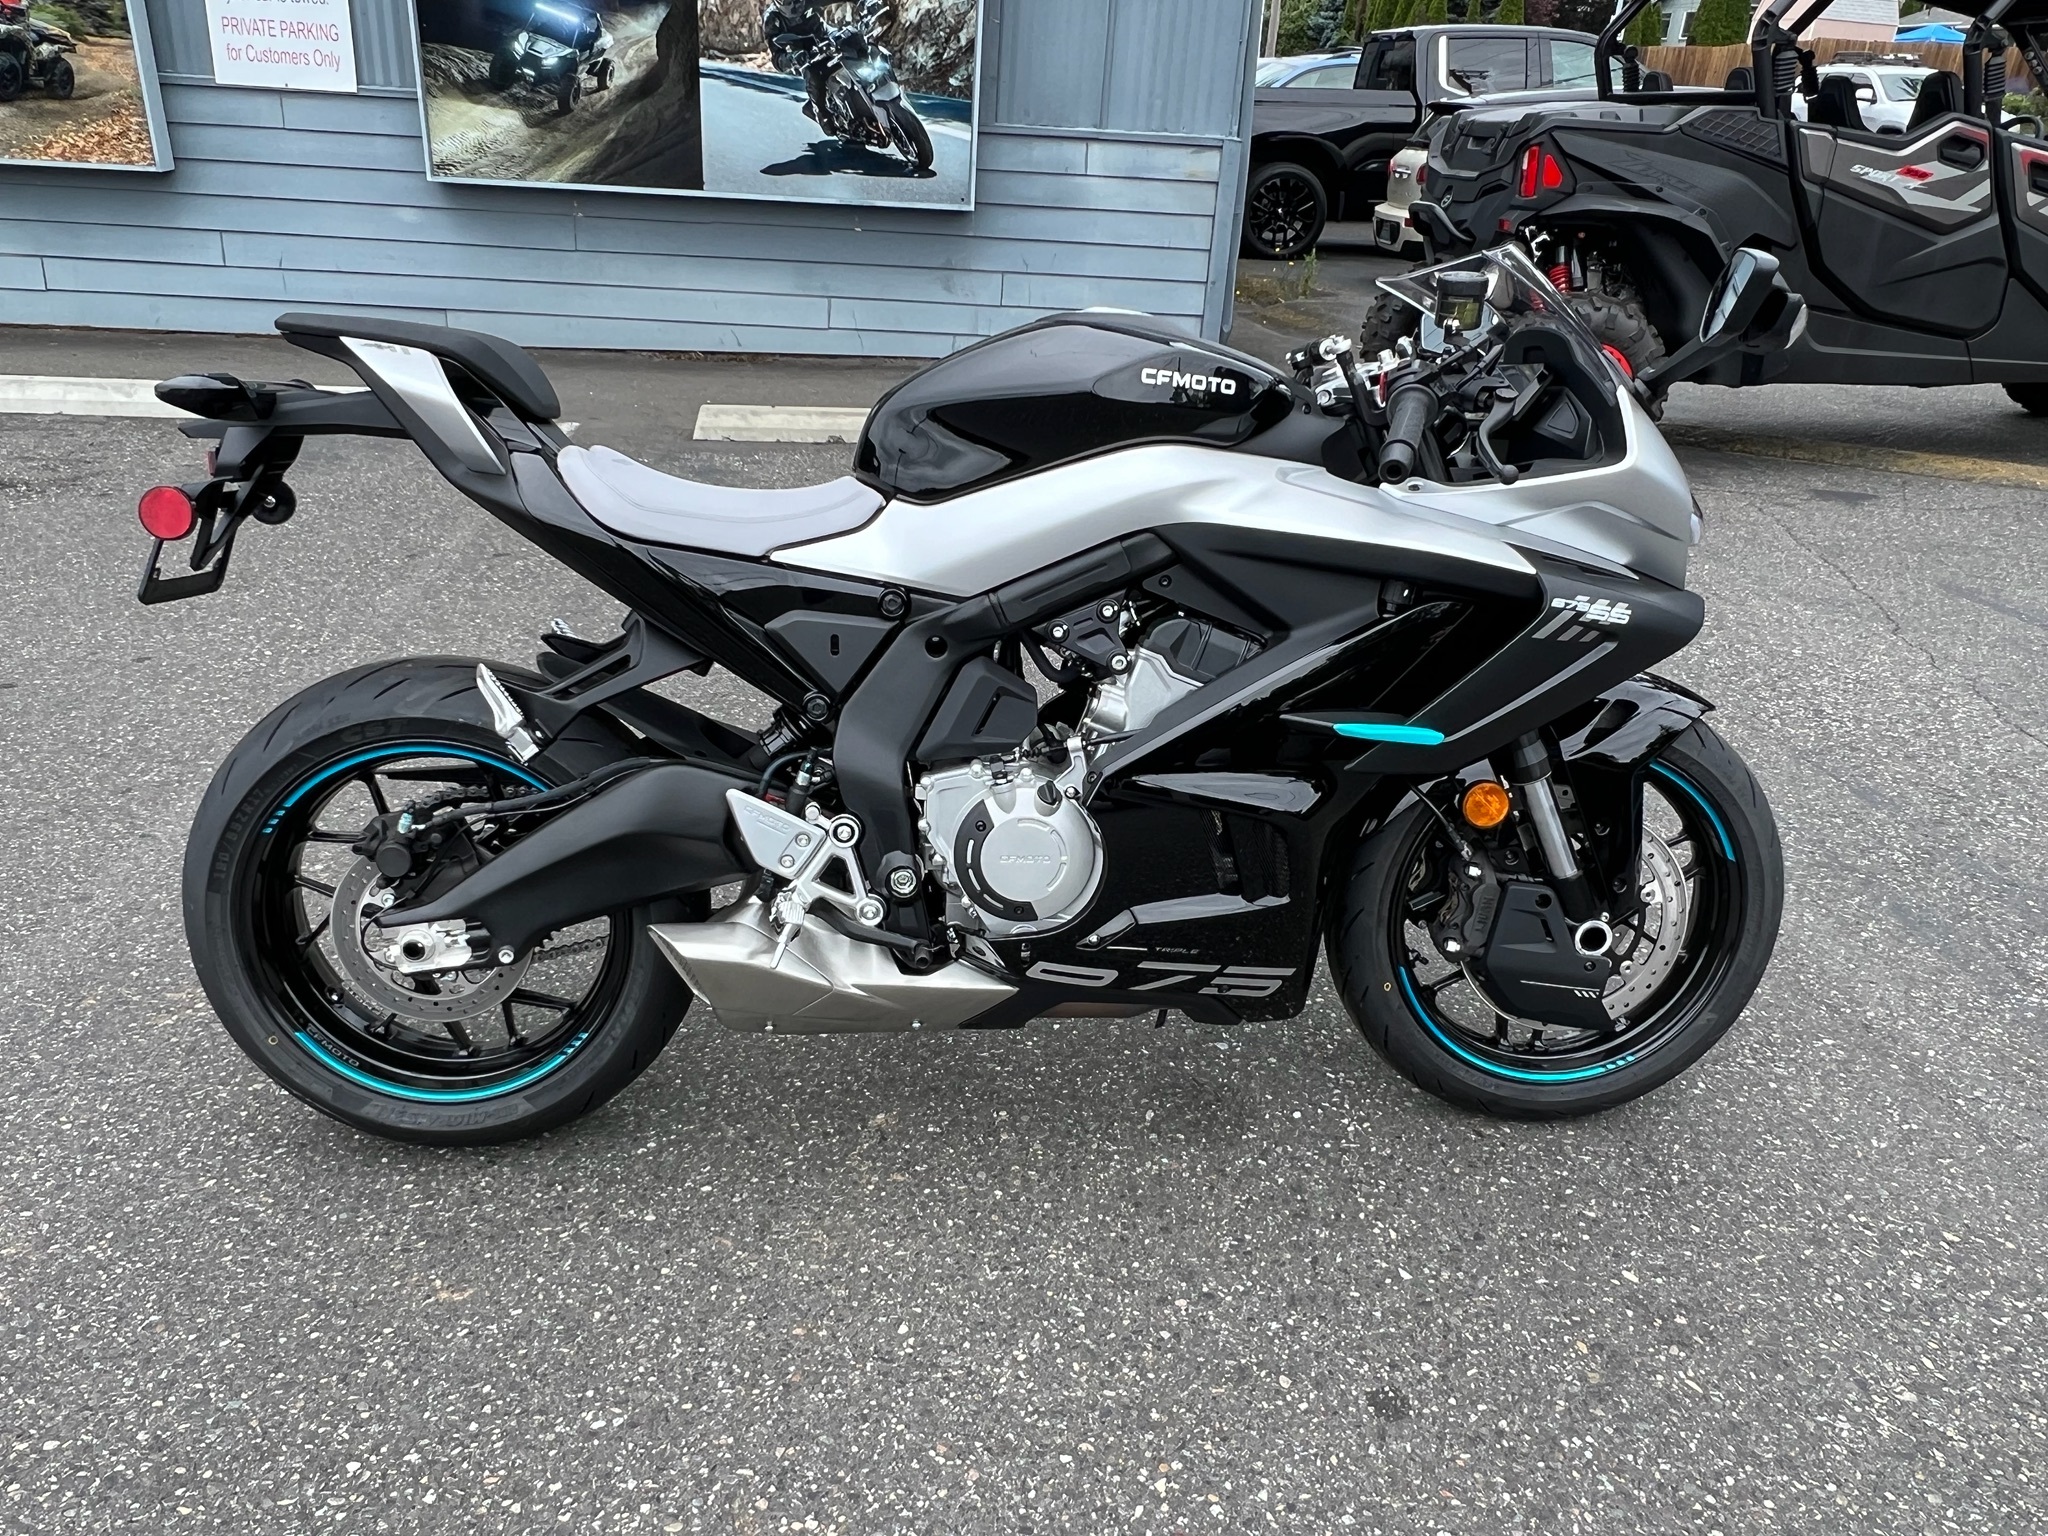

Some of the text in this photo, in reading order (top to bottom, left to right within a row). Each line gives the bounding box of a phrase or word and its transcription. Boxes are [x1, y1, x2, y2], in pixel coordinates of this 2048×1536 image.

[221, 16, 340, 42] PRIVATE PARKING
[226, 43, 341, 73] for Customers Only
[1141, 367, 1237, 395] CFMOTO
[743, 804, 792, 832] CFMOTO
[1000, 854, 1051, 864] CFMOTO
[1155, 946, 1199, 954] TRIPLE
[305, 1022, 360, 1067] CFMOTO
